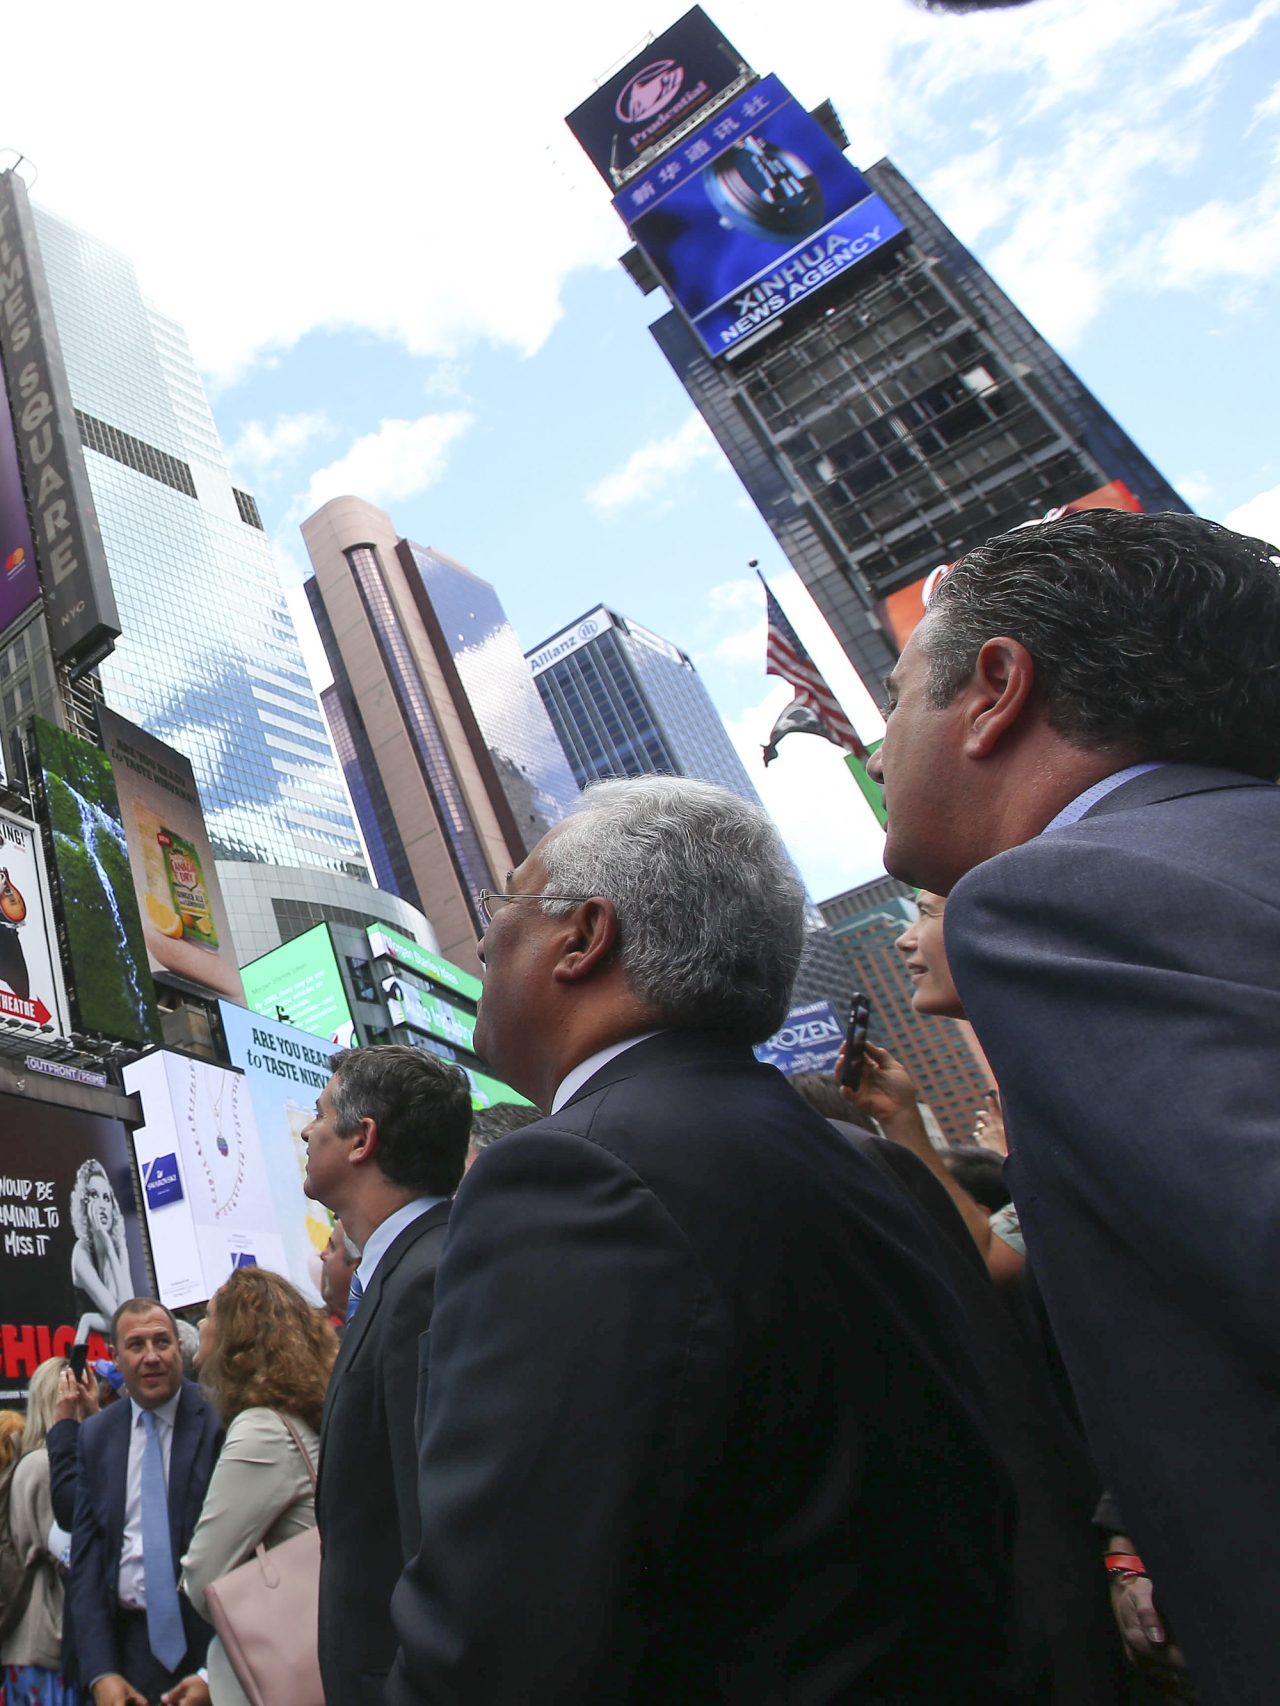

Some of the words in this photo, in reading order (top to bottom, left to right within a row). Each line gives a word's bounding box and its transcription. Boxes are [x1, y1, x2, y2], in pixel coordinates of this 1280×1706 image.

[629, 80, 709, 147] Prudential
[719, 294, 786, 344] NEWS
[788, 225, 881, 300] AGENCY
[733, 233, 851, 316] XINHUA
[19, 361, 78, 586] SQUARE
[60, 600, 85, 627] NYC
[529, 635, 576, 673] Allianz
[252, 1027, 276, 1051] ARE
[276, 1036, 301, 1060] YOU
[247, 1049, 262, 1069] to
[262, 1055, 300, 1082] TASTE
[35, 1181, 55, 1201] BE
[43, 1207, 60, 1229] TO
[4, 1230, 34, 1257] MISS
[35, 1235, 50, 1256] IT
